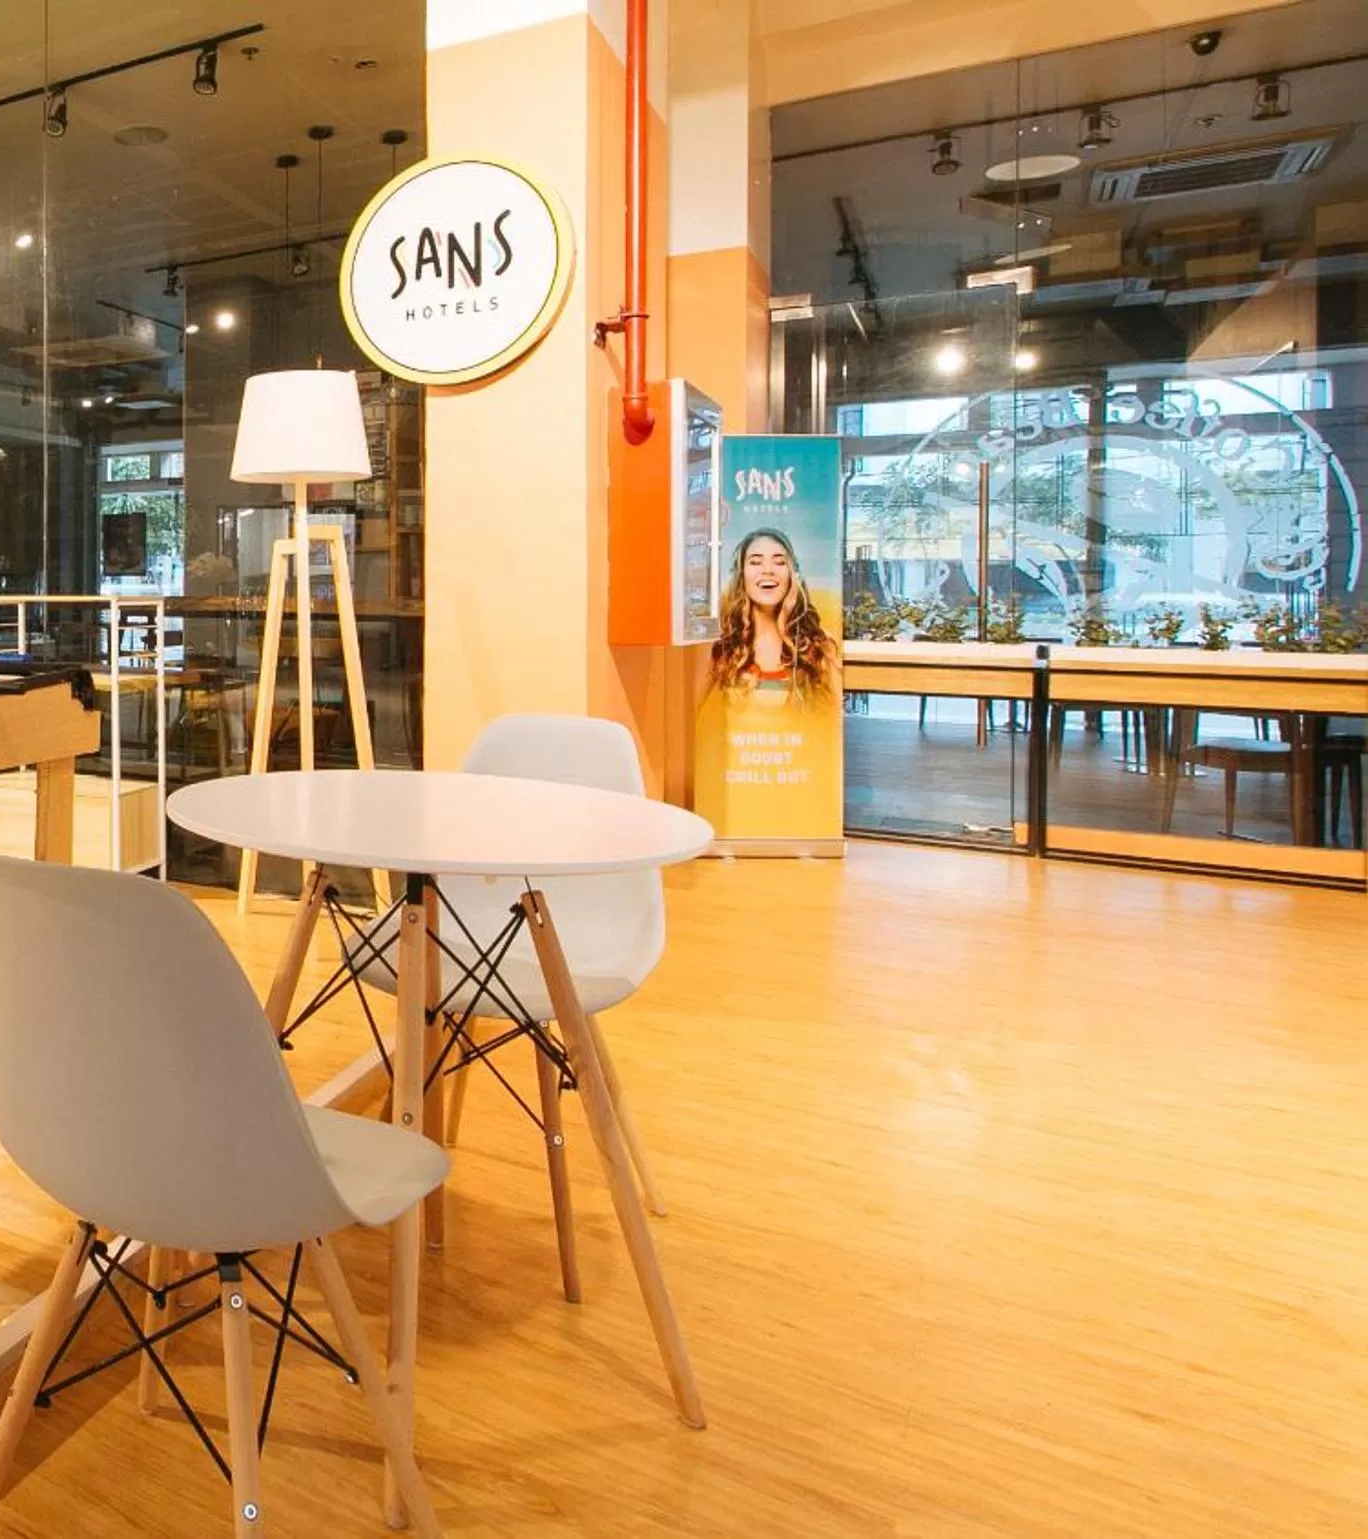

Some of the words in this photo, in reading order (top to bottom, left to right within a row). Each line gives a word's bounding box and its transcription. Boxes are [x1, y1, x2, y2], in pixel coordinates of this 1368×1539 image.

[390, 209, 513, 299] SANS
[405, 297, 500, 321] HOTELS
[735, 466, 796, 502] SANS
